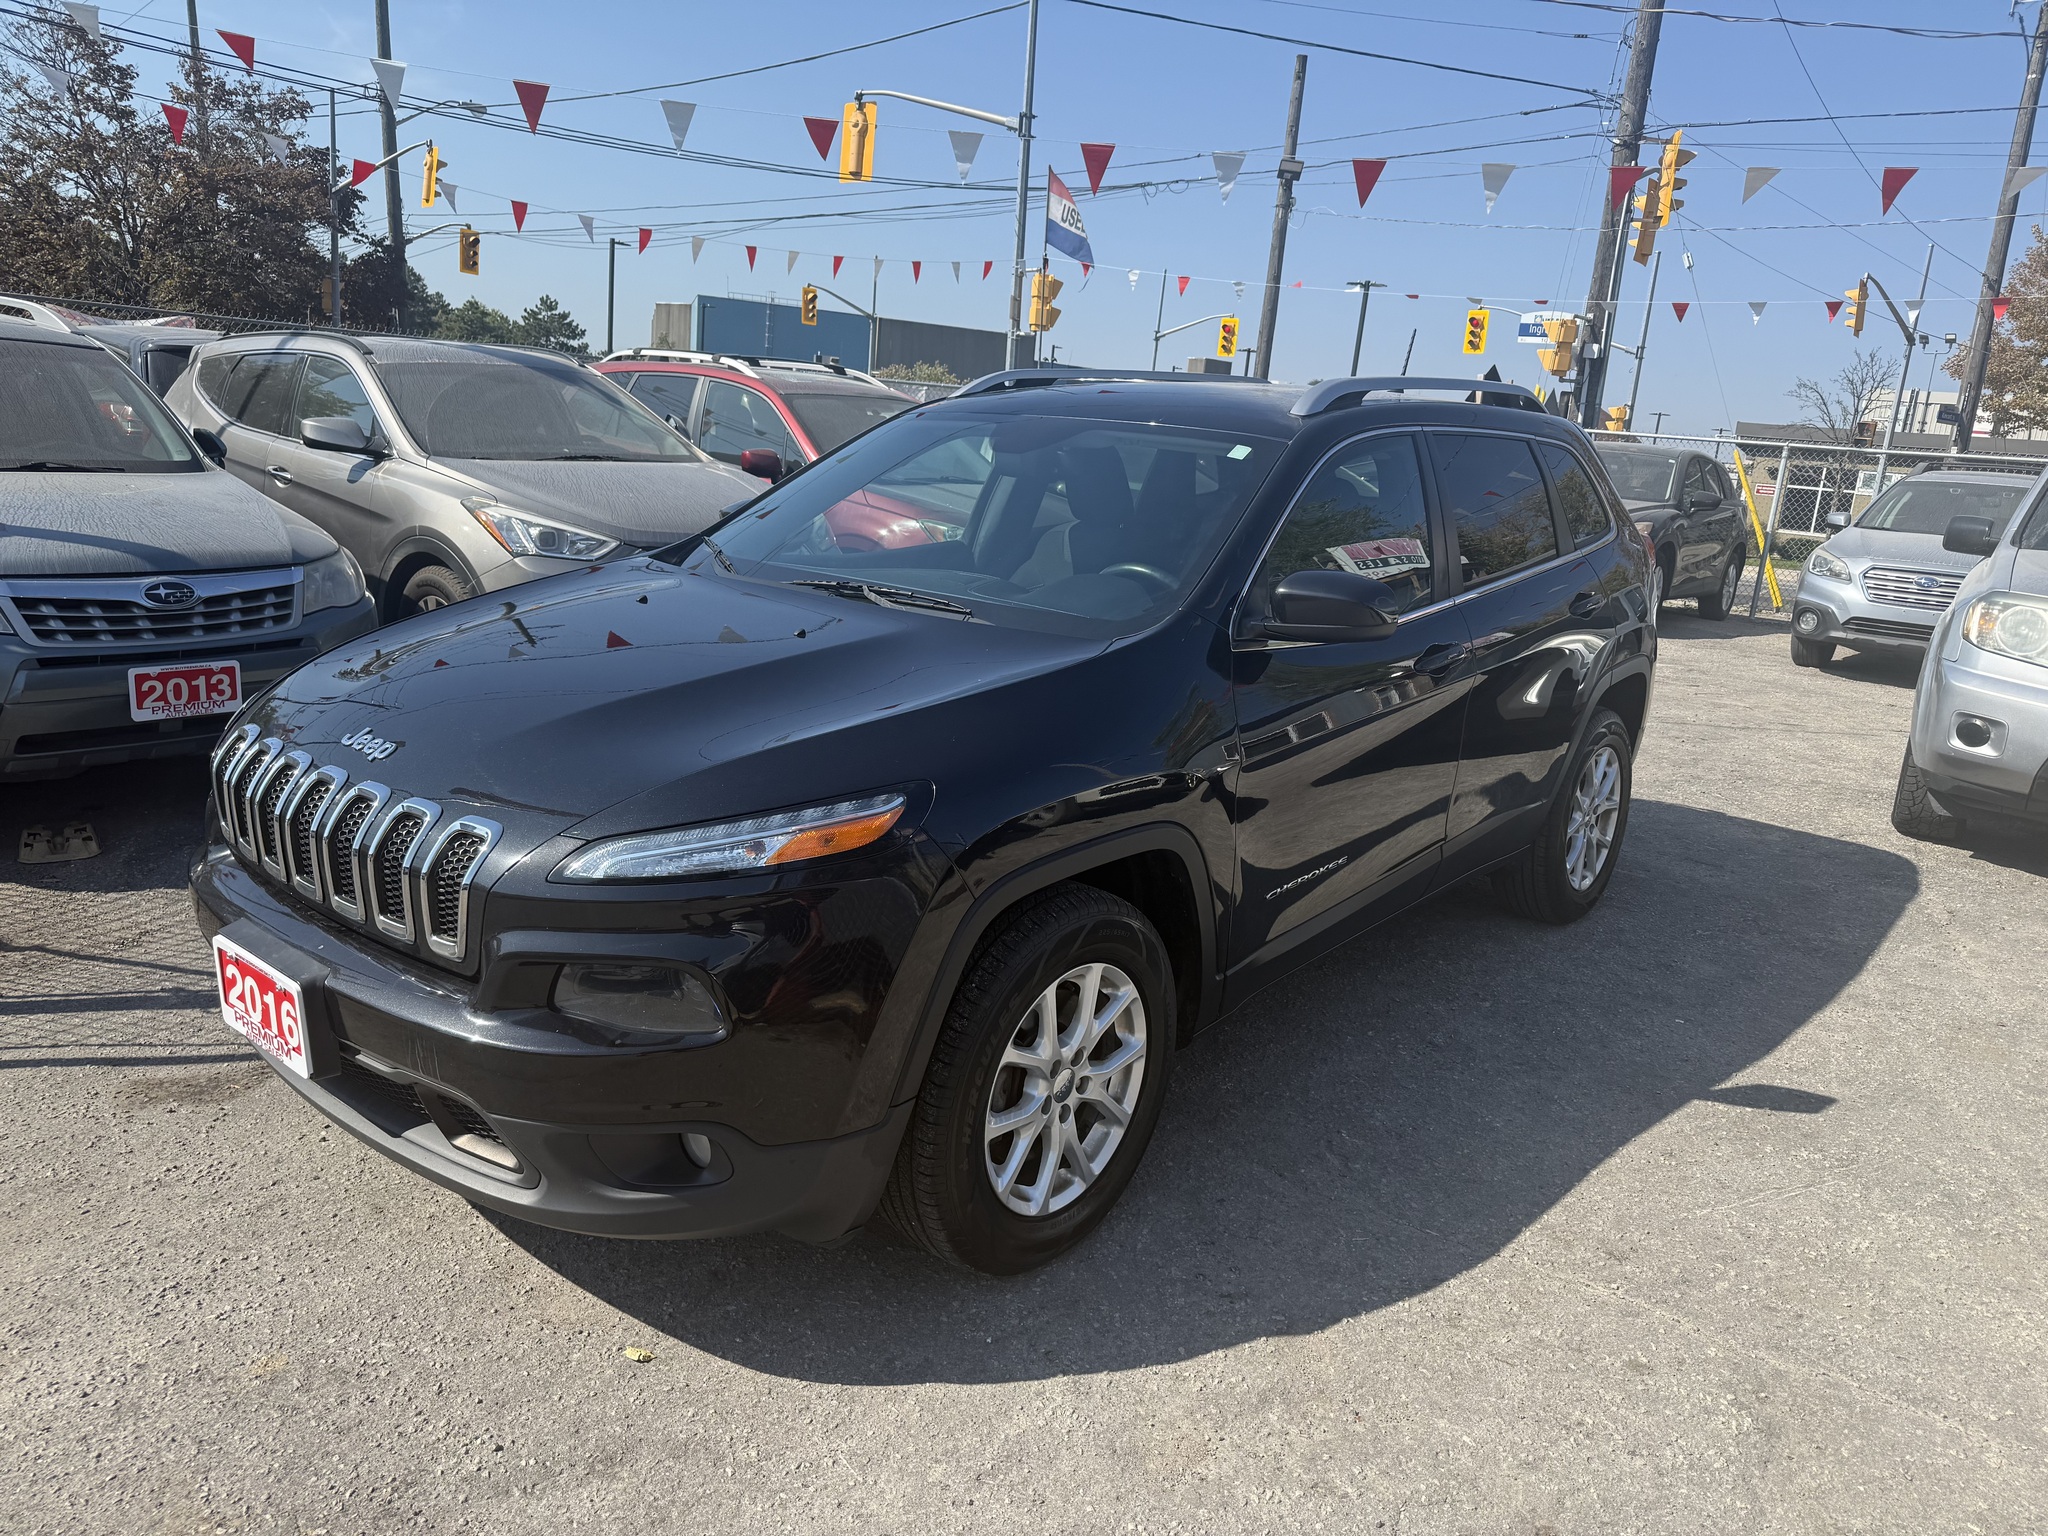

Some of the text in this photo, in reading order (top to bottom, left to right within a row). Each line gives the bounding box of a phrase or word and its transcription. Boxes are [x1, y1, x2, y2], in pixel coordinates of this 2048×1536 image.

[1529, 324, 1547, 336] Ingr
[141, 674, 232, 709] 2013
[151, 700, 225, 715] PREMIUM
[190, 708, 214, 716] SALES
[341, 727, 397, 761] Jeep
[1264, 855, 1348, 900] CHEROKEE
[226, 964, 300, 1048] 2016
[234, 1010, 292, 1061] PREMIUM
